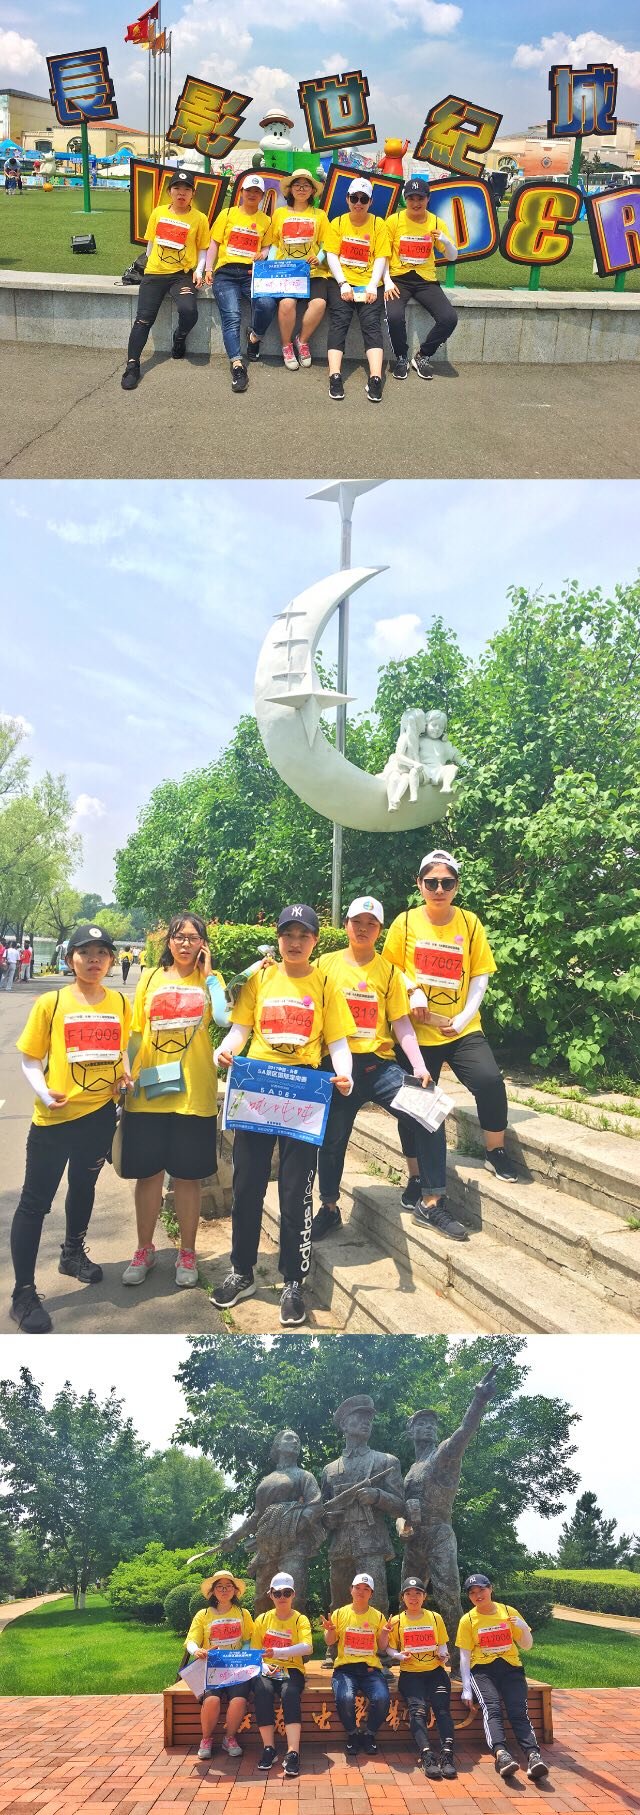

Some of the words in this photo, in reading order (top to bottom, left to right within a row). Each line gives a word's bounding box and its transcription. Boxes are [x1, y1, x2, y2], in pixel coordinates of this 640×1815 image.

[416, 953, 462, 971] F17007
[68, 1028, 120, 1043] F17005
[299, 1205, 312, 1273] adidas
